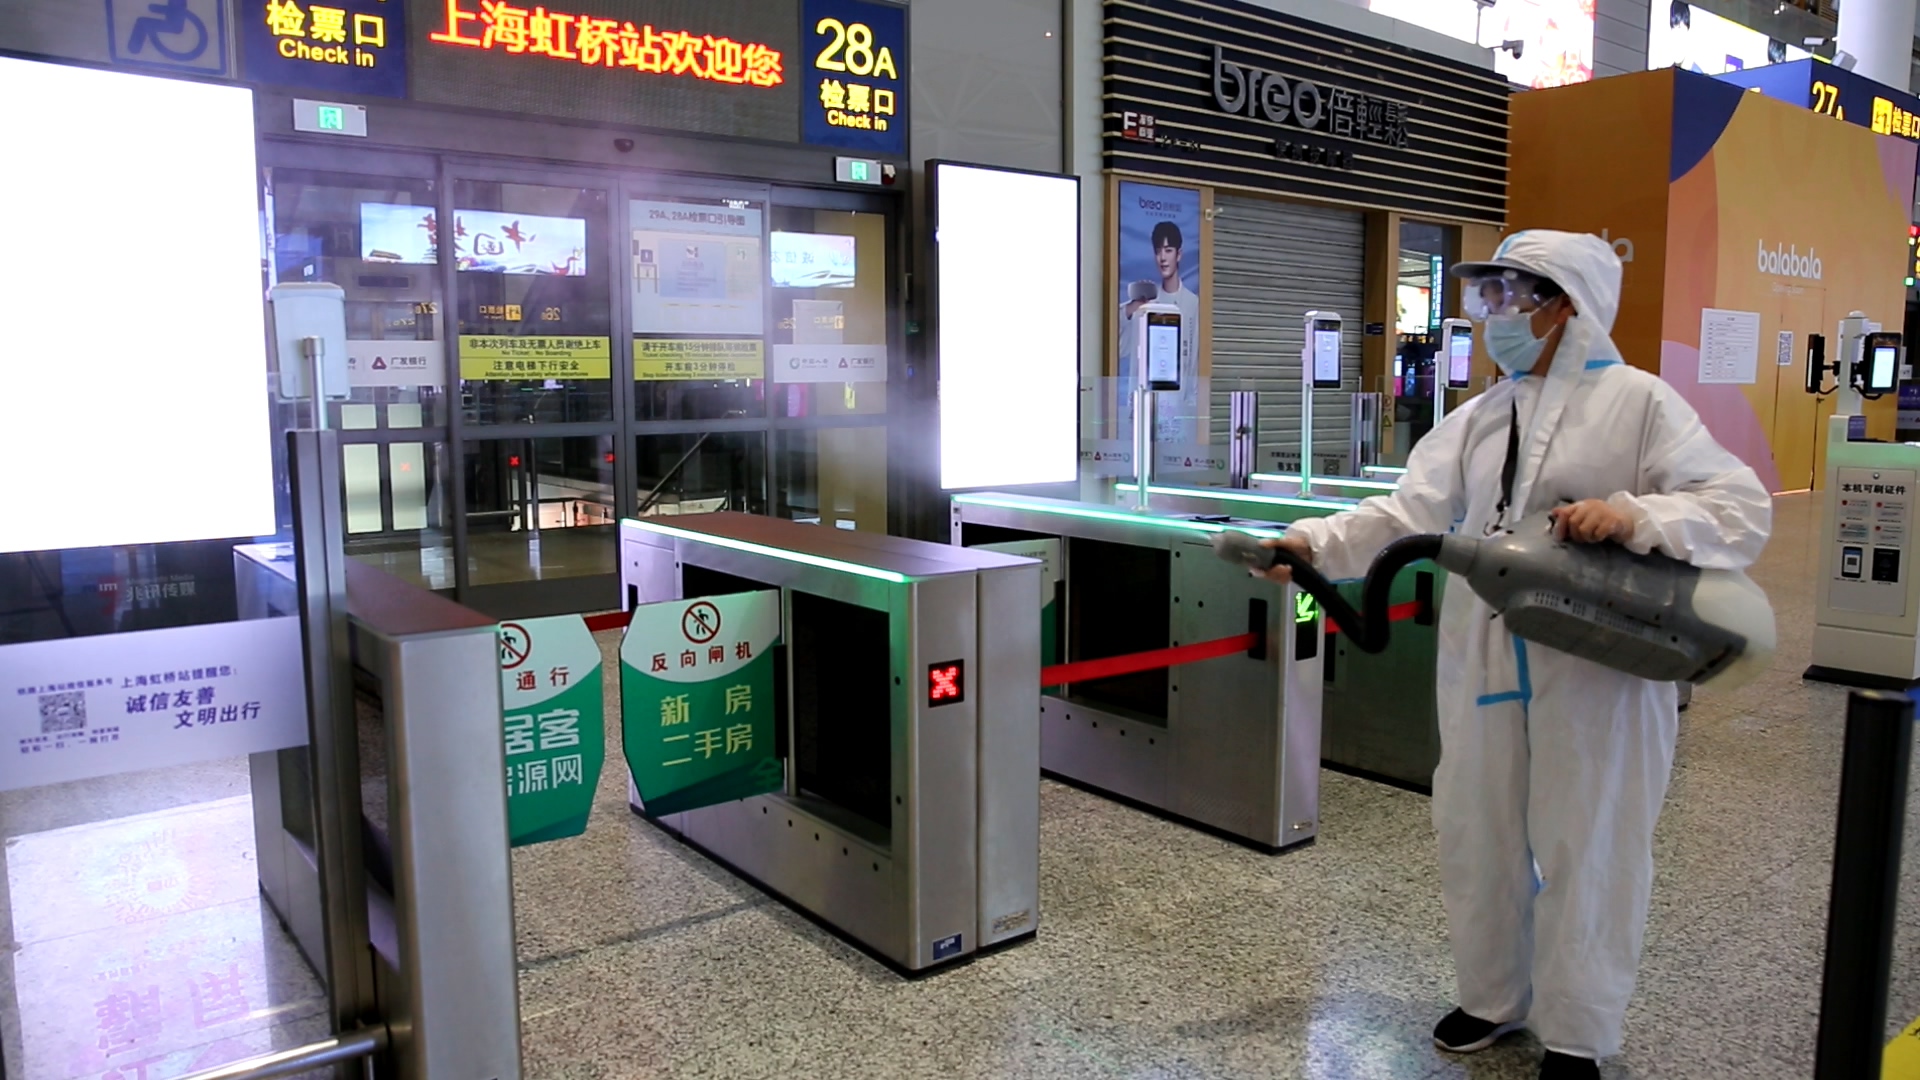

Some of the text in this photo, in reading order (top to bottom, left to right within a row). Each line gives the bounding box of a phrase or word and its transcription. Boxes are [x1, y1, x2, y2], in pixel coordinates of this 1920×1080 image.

[266, 0, 385, 48] 检票口
[279, 38, 374, 68] Check in
[430, 0, 784, 89] 上海虹桥站欢迎您
[815, 17, 898, 80] 28A
[819, 78, 895, 116] 检票口
[1214, 45, 1322, 129] breo
[827, 109, 888, 132] Check in
[1757, 238, 1822, 280] balabala
[493, 360, 580, 371] 注意电梯下行安全
[1841, 483, 1907, 495] 本机可刷证件
[651, 641, 753, 673] 反向闸机
[516, 666, 570, 691] 通行
[126, 686, 215, 714] 诚信友善
[174, 701, 261, 730] 文明出行
[504, 708, 580, 756] 居客
[662, 723, 753, 767] 二手房
